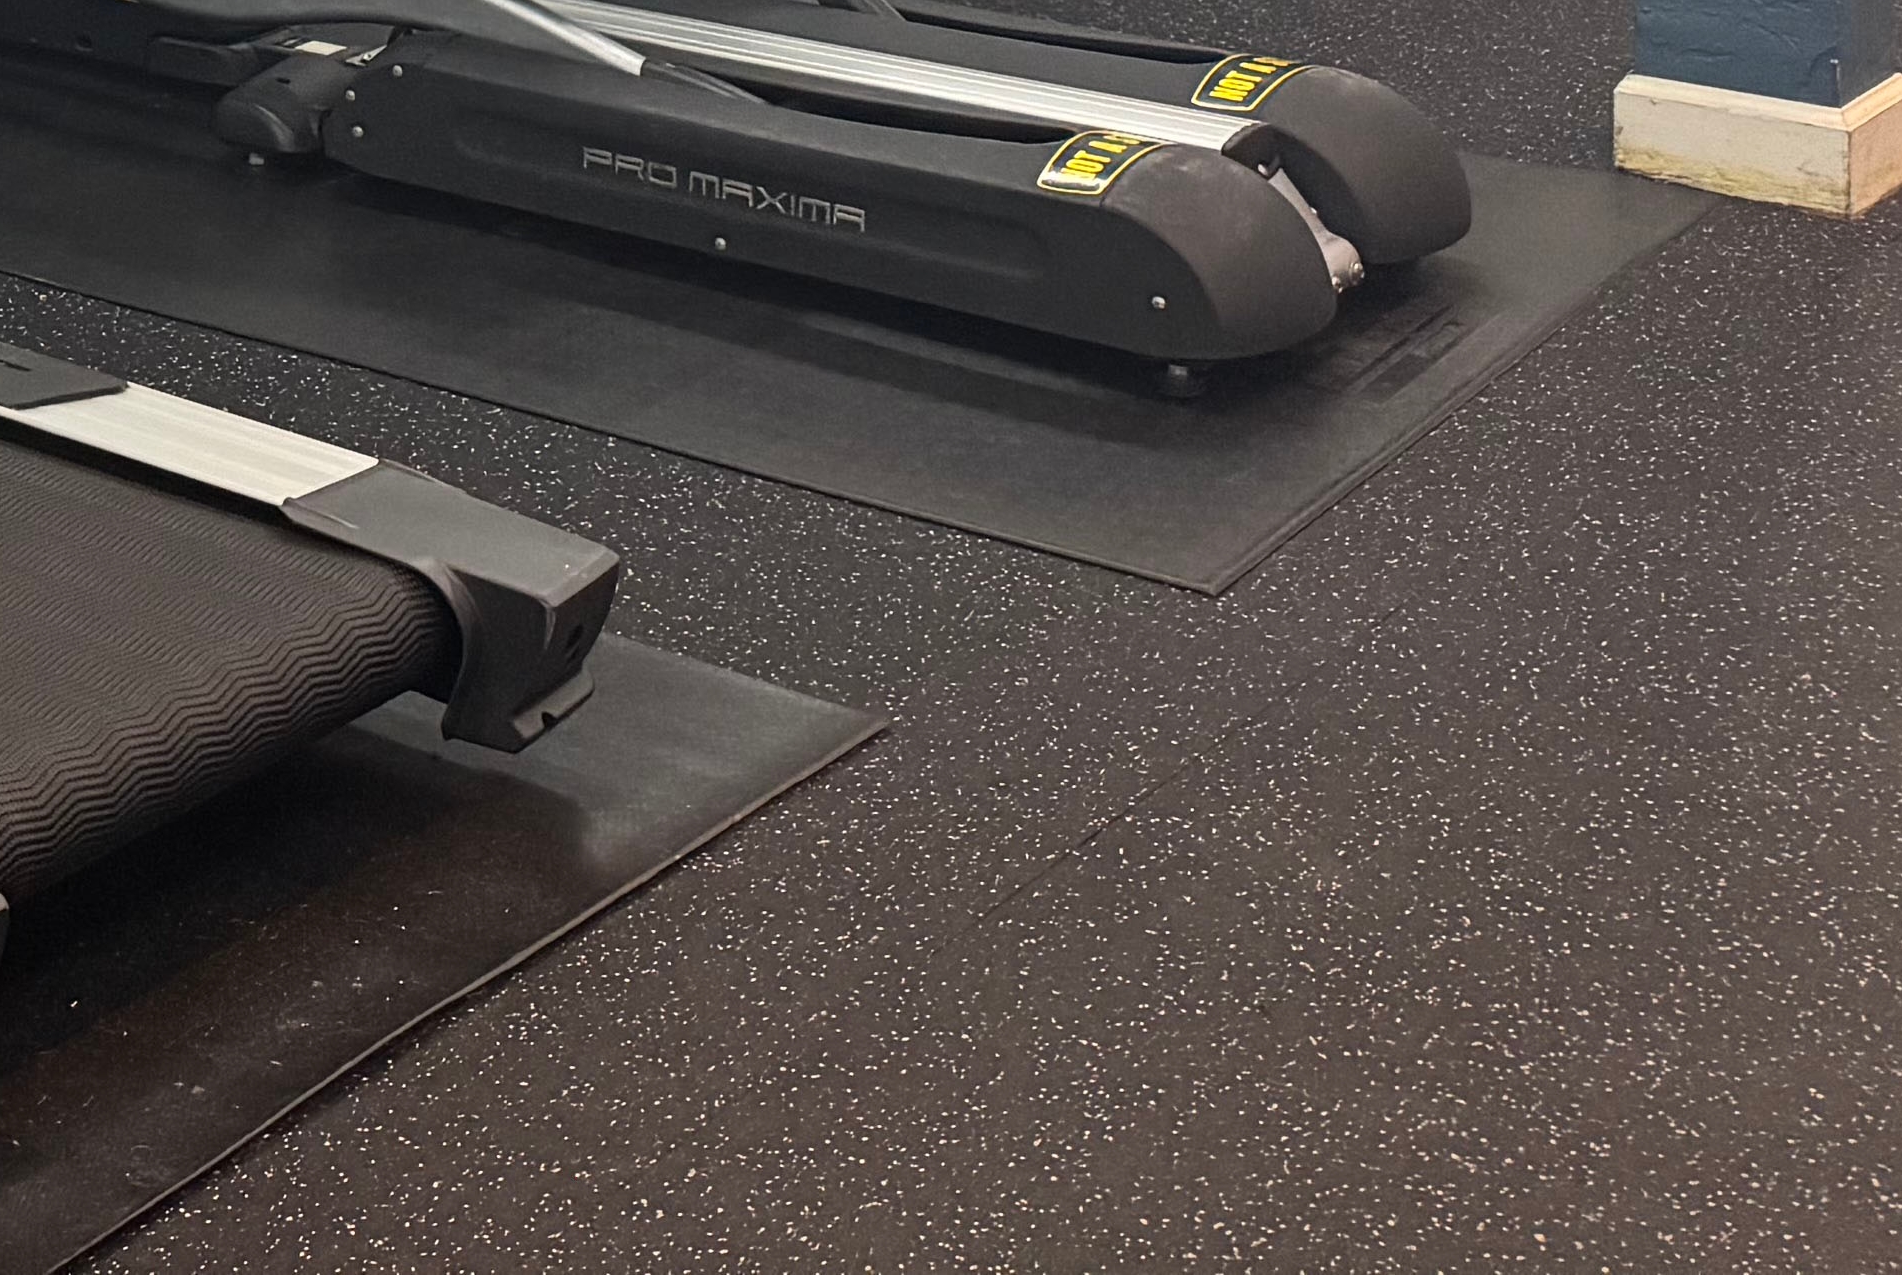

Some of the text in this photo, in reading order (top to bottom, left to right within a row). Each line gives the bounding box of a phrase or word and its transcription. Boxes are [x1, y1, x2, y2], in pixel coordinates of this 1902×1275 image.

[1208, 69, 1263, 103] NOT
[1239, 61, 1278, 75] A
[1088, 140, 1129, 154] A
[582, 145, 866, 233] PRO MAXIMA
